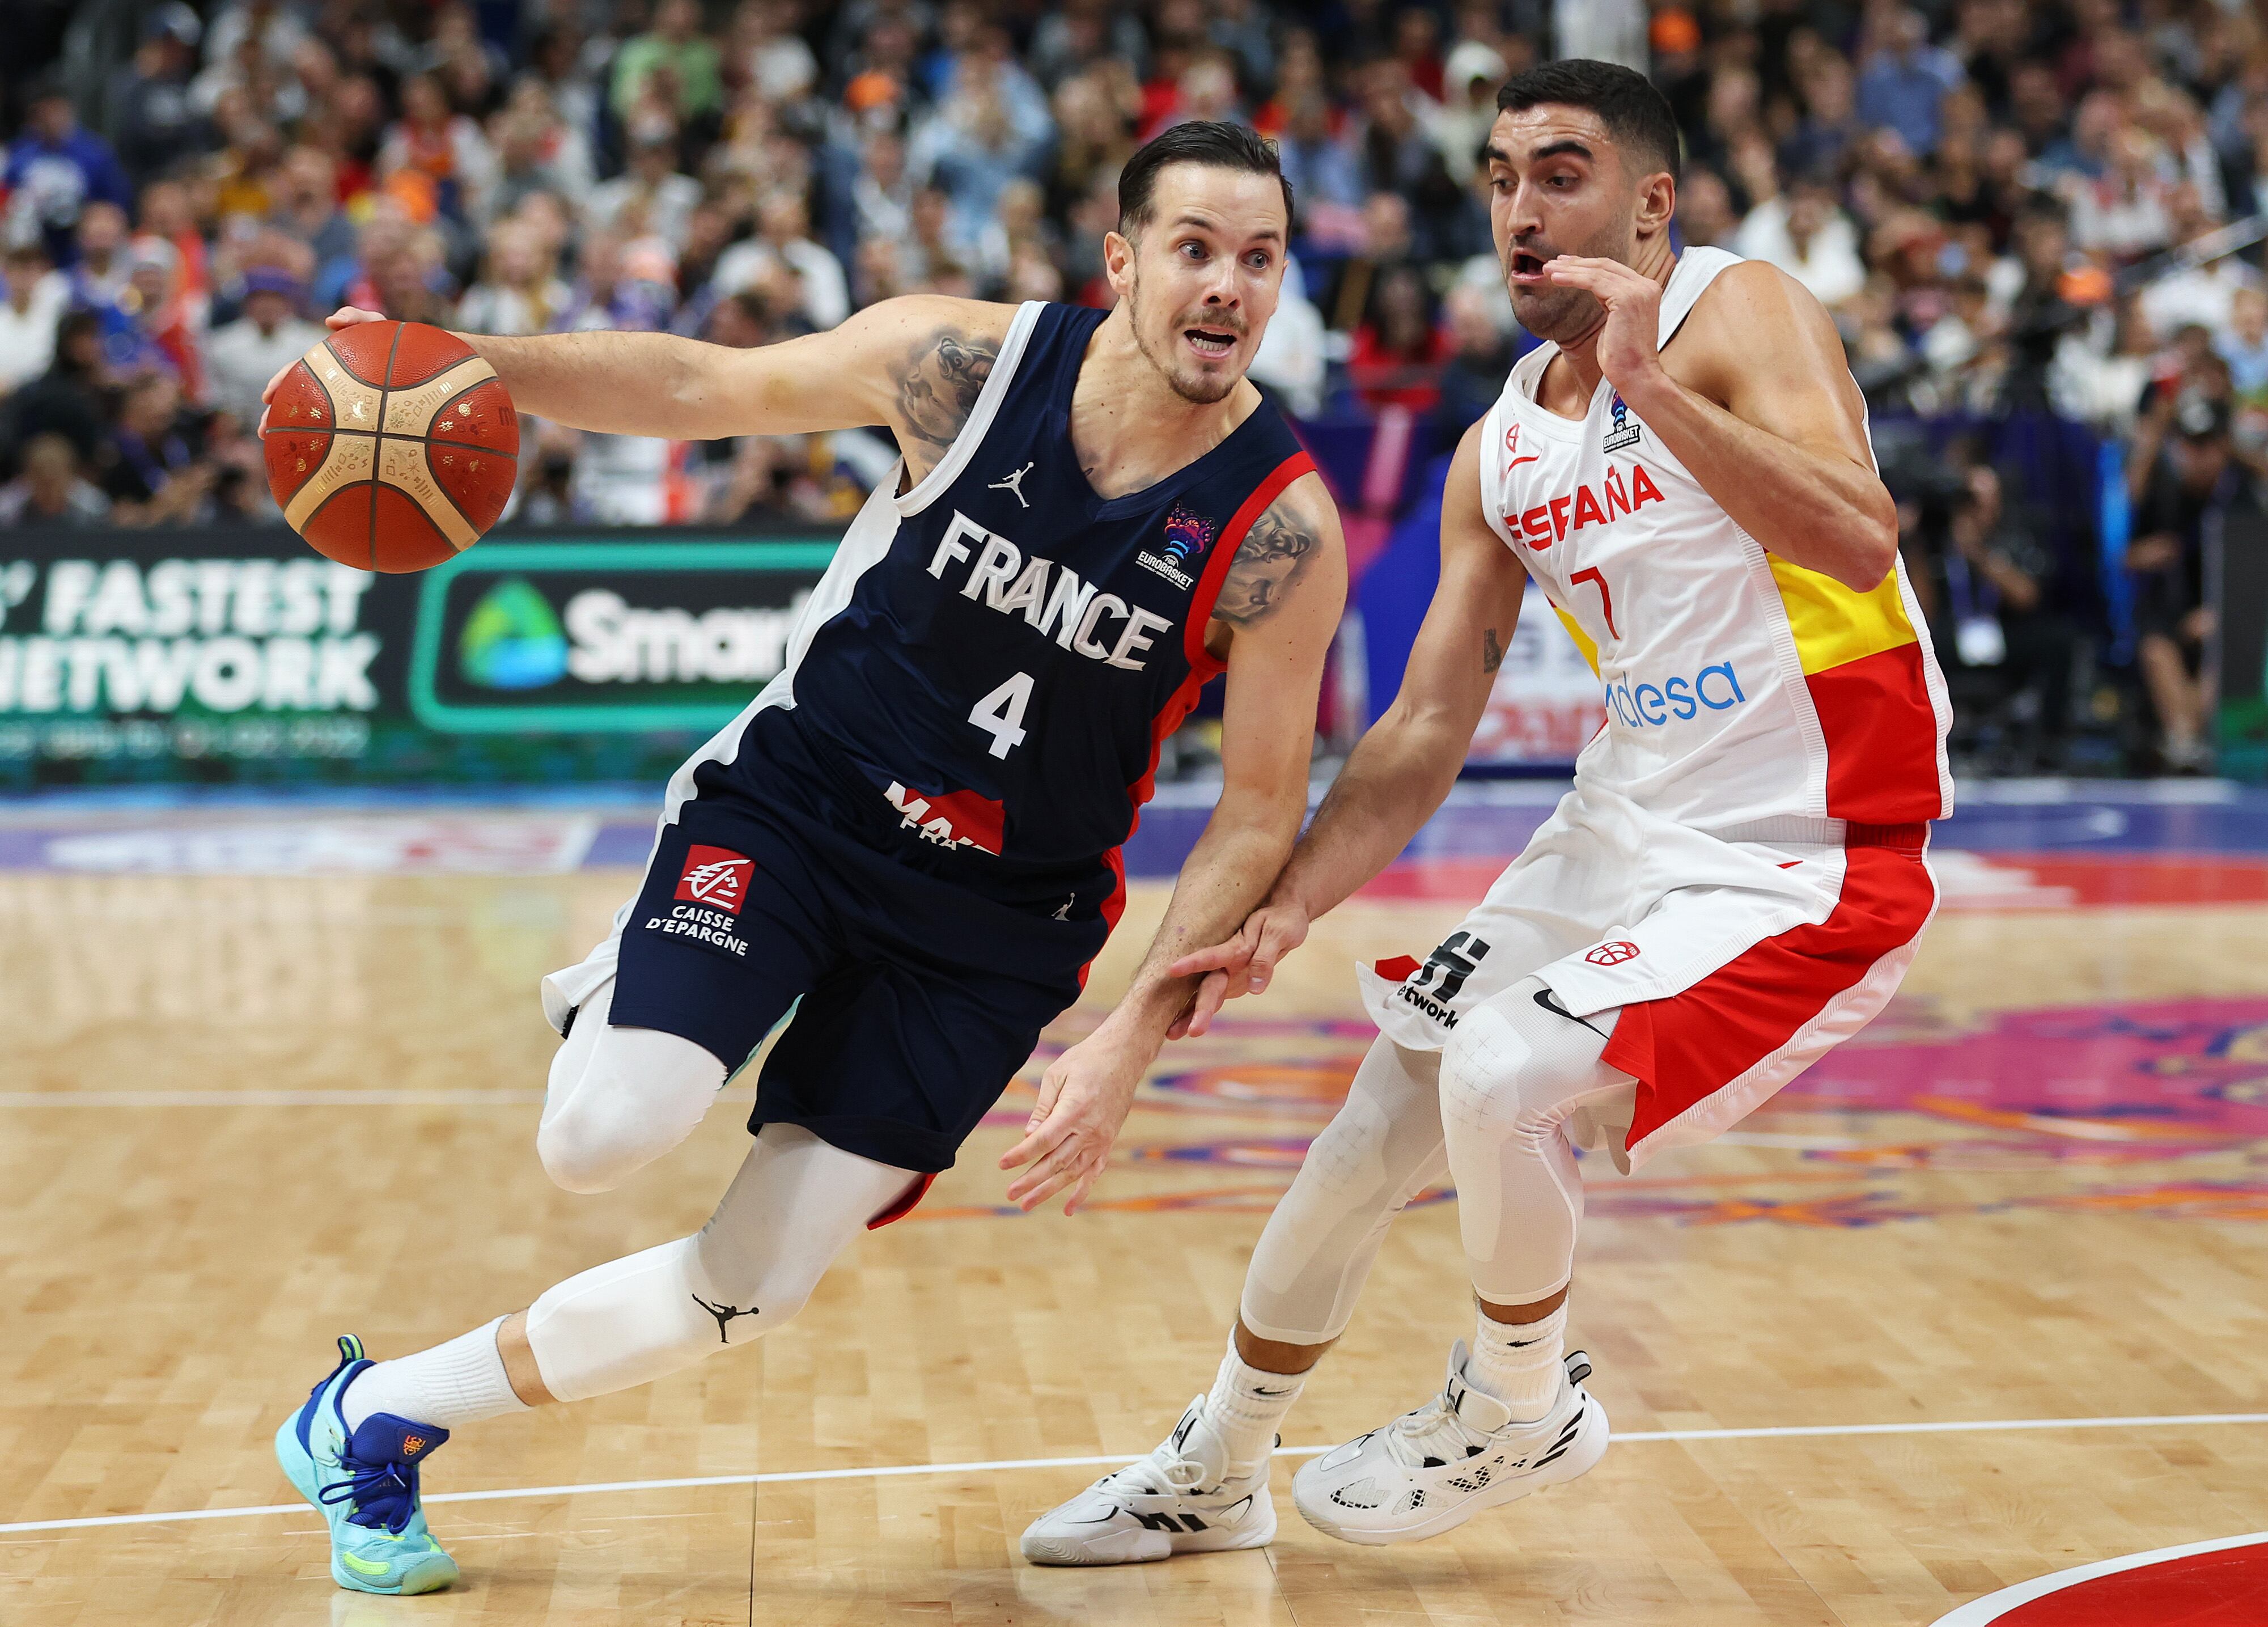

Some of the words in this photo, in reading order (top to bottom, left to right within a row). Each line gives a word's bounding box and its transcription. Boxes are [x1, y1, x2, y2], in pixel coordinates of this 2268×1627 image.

[43, 558, 374, 635] FASTEST
[926, 509, 1174, 671] FRANCE
[1137, 550, 1194, 588] EUROBASKET
[1570, 566, 1621, 641] 7
[968, 671, 1035, 760] 4
[883, 780, 1000, 857] MA
[645, 918, 749, 956] D'EPARGNE
[672, 905, 735, 932] CAISSE
